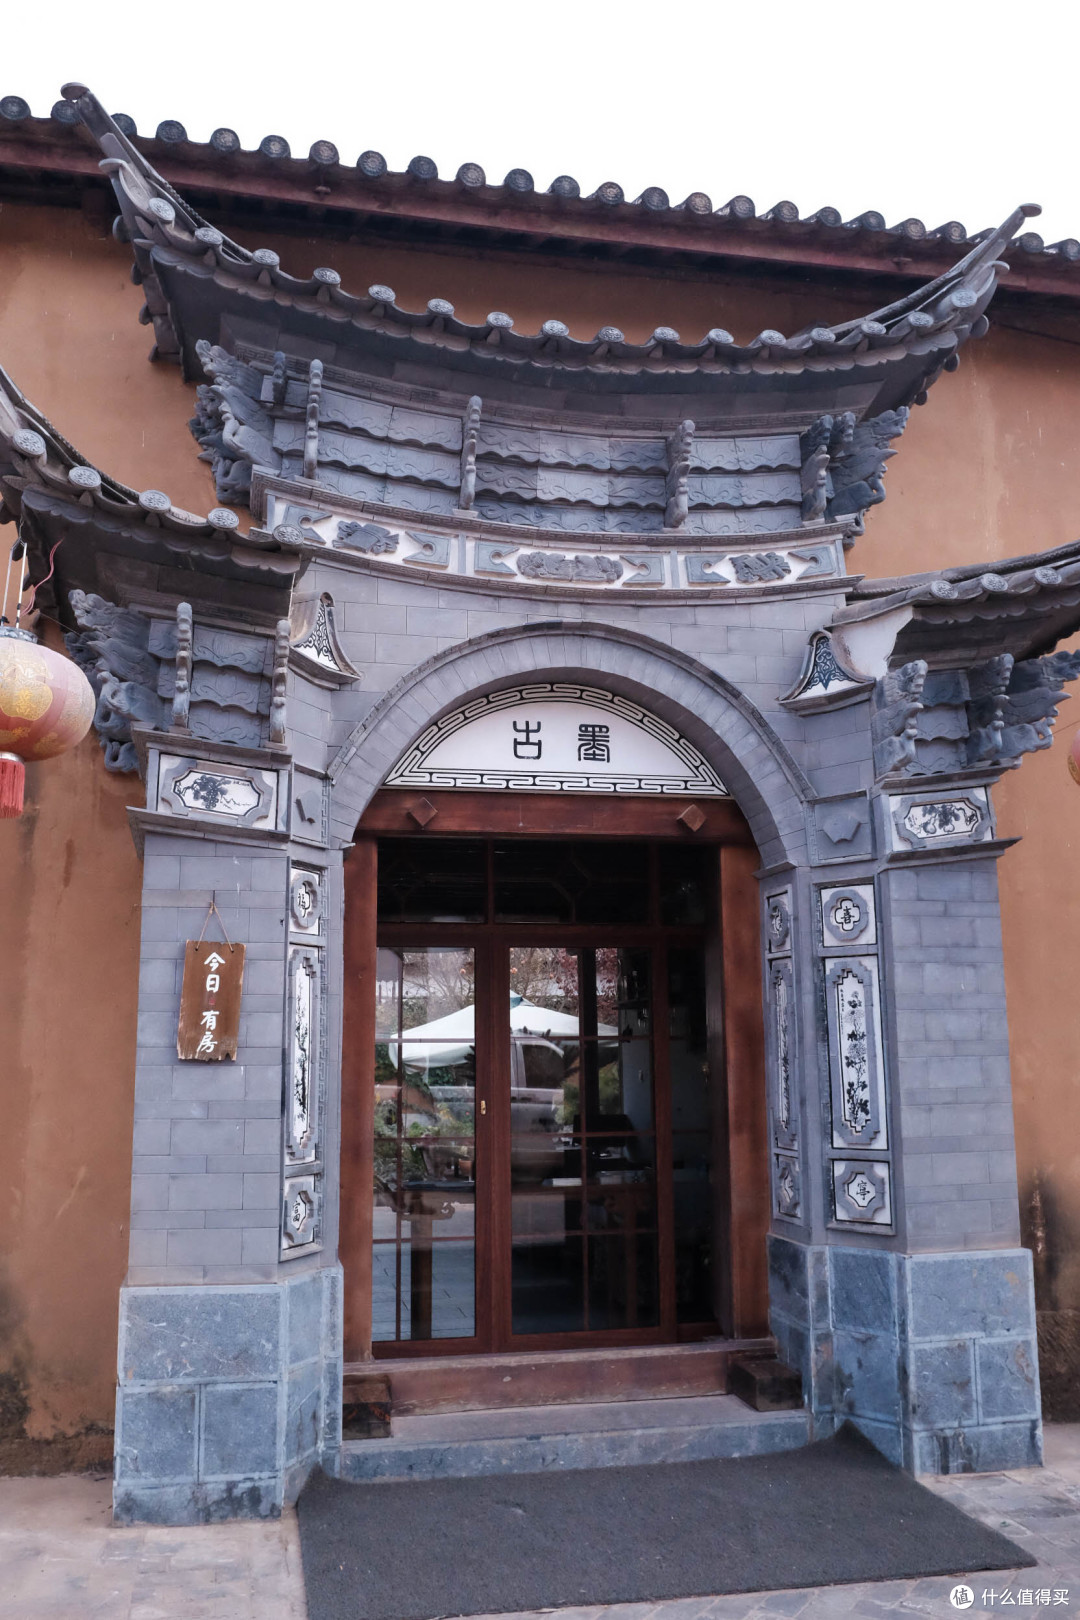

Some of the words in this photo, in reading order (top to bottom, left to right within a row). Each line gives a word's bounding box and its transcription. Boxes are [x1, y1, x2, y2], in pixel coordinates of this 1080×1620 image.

[840, 905, 856, 924] 喜
[200, 951, 226, 1053] 今日有房
